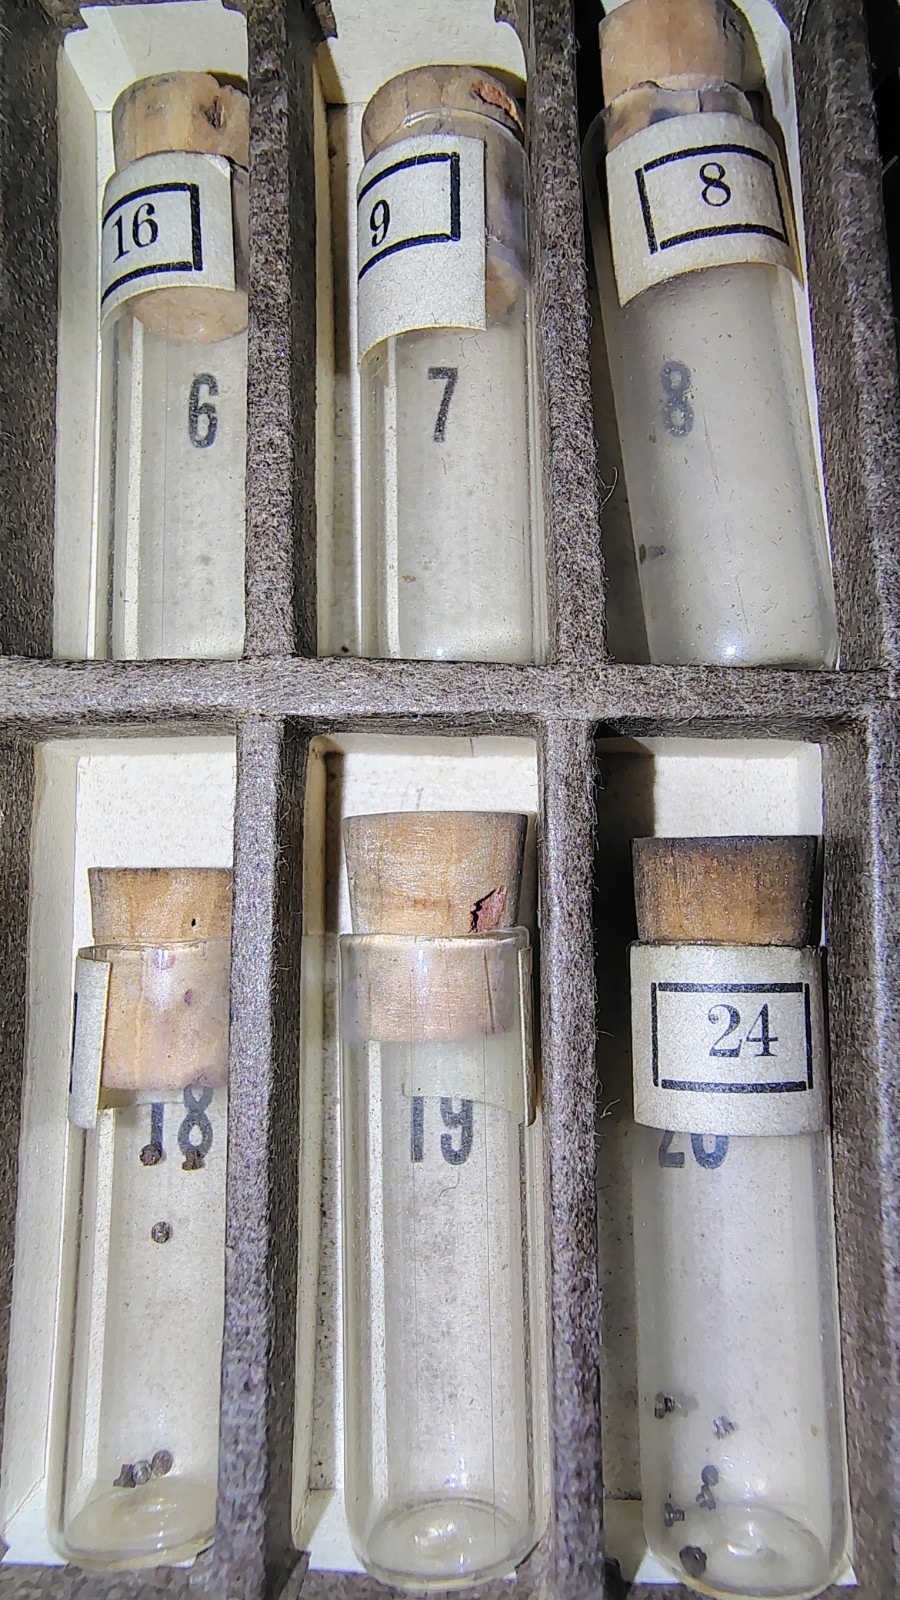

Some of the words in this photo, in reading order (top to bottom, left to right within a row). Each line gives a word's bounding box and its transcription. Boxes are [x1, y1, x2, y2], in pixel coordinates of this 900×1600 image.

[699, 162, 731, 207] 8
[111, 203, 159, 263] 16
[370, 199, 391, 248] 9
[188, 372, 219, 448] 6
[427, 366, 458, 443] 7
[660, 360, 694, 437] 8
[707, 1003, 779, 1058] 24
[150, 1080, 214, 1160] 18
[410, 1096, 474, 1166] 19
